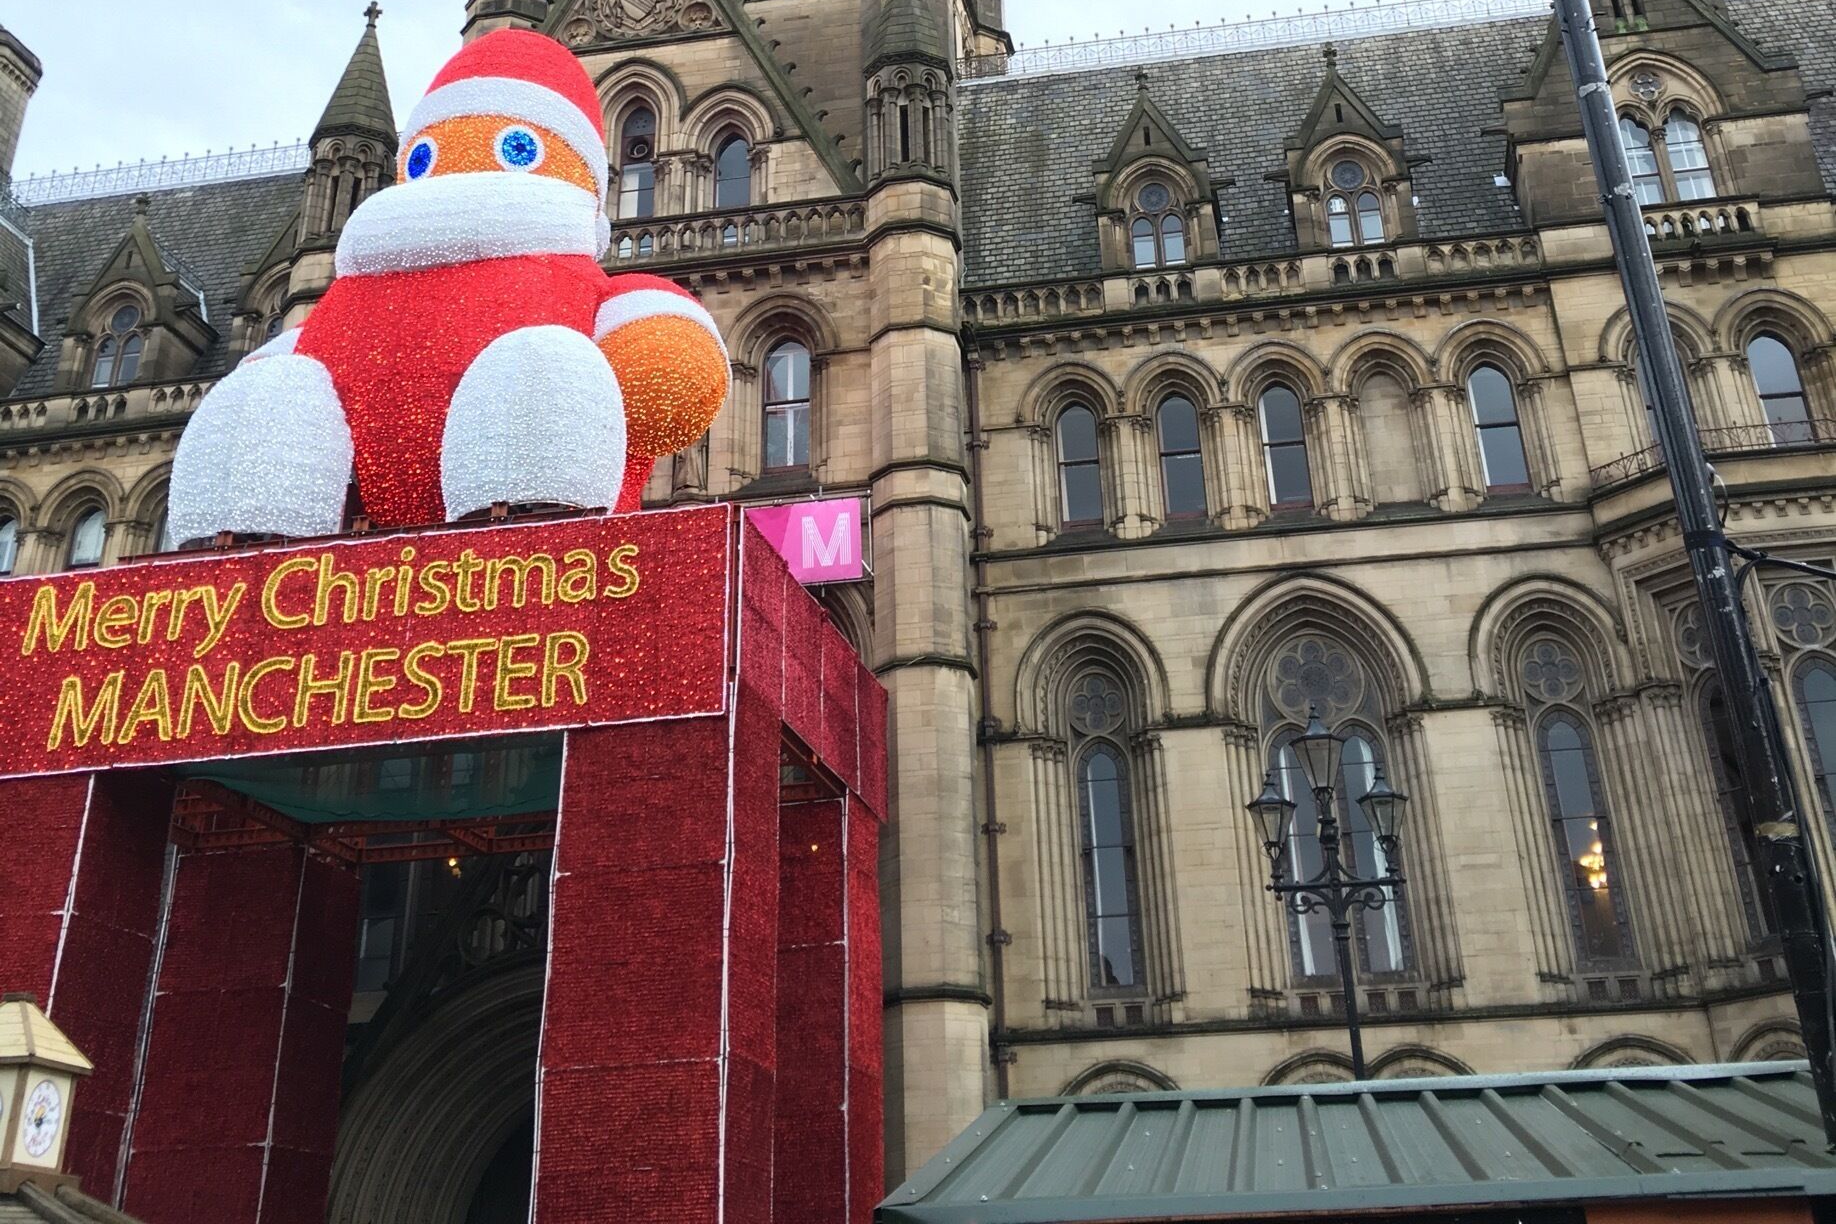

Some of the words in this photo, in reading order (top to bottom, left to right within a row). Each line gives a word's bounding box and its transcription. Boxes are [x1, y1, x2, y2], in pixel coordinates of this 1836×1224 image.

[801, 512, 851, 569] M
[22, 581, 246, 657] Merry
[261, 545, 640, 629] Christmas
[47, 631, 590, 751] MANCHESTER
